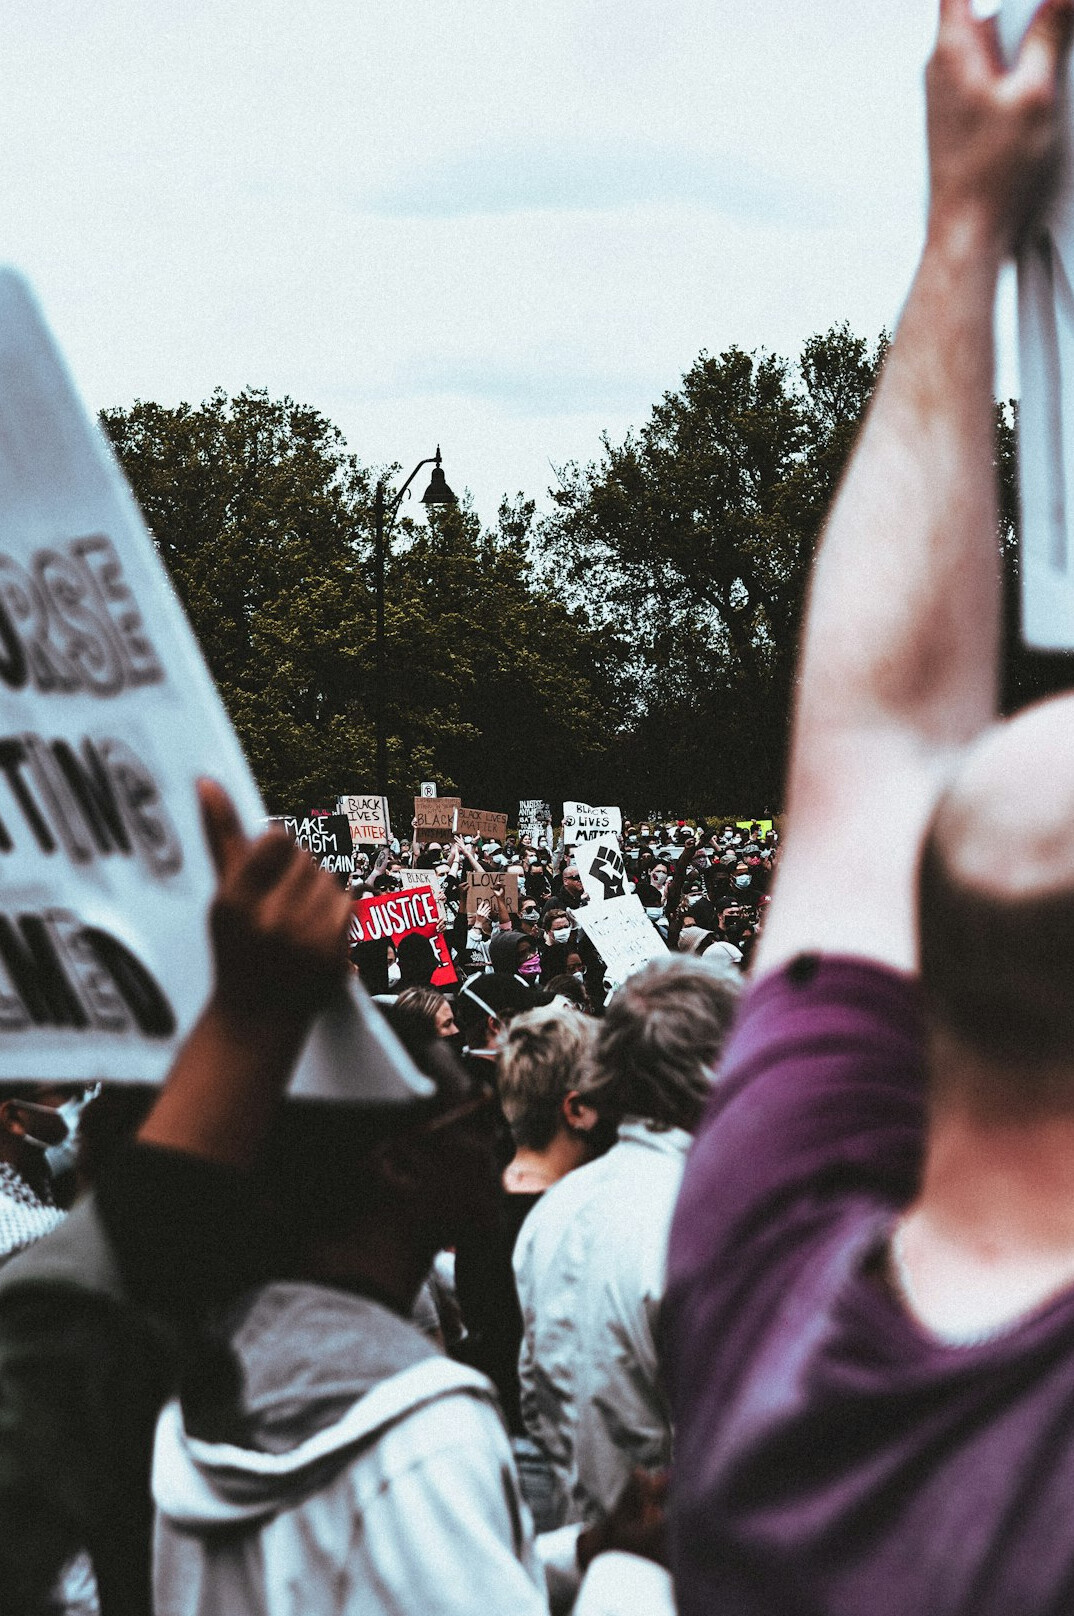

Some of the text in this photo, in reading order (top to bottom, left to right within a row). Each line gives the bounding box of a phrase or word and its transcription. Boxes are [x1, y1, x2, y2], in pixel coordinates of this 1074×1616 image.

[0, 532, 166, 698] RSE
[0, 732, 184, 880] TING
[348, 798, 381, 811] BLACK
[576, 804, 607, 816] BLACK
[346, 811, 380, 821] IVES
[418, 813, 454, 827] BLACK
[460, 810, 482, 820] BLACK
[486, 812, 506, 824] LIVES
[284, 816, 329, 836] MAKE
[461, 820, 498, 833] MATTER
[293, 833, 338, 853] ACISM
[319, 854, 355, 873] AGAIN
[406, 872, 431, 884] BLACK
[366, 893, 438, 940] JUSTICE
